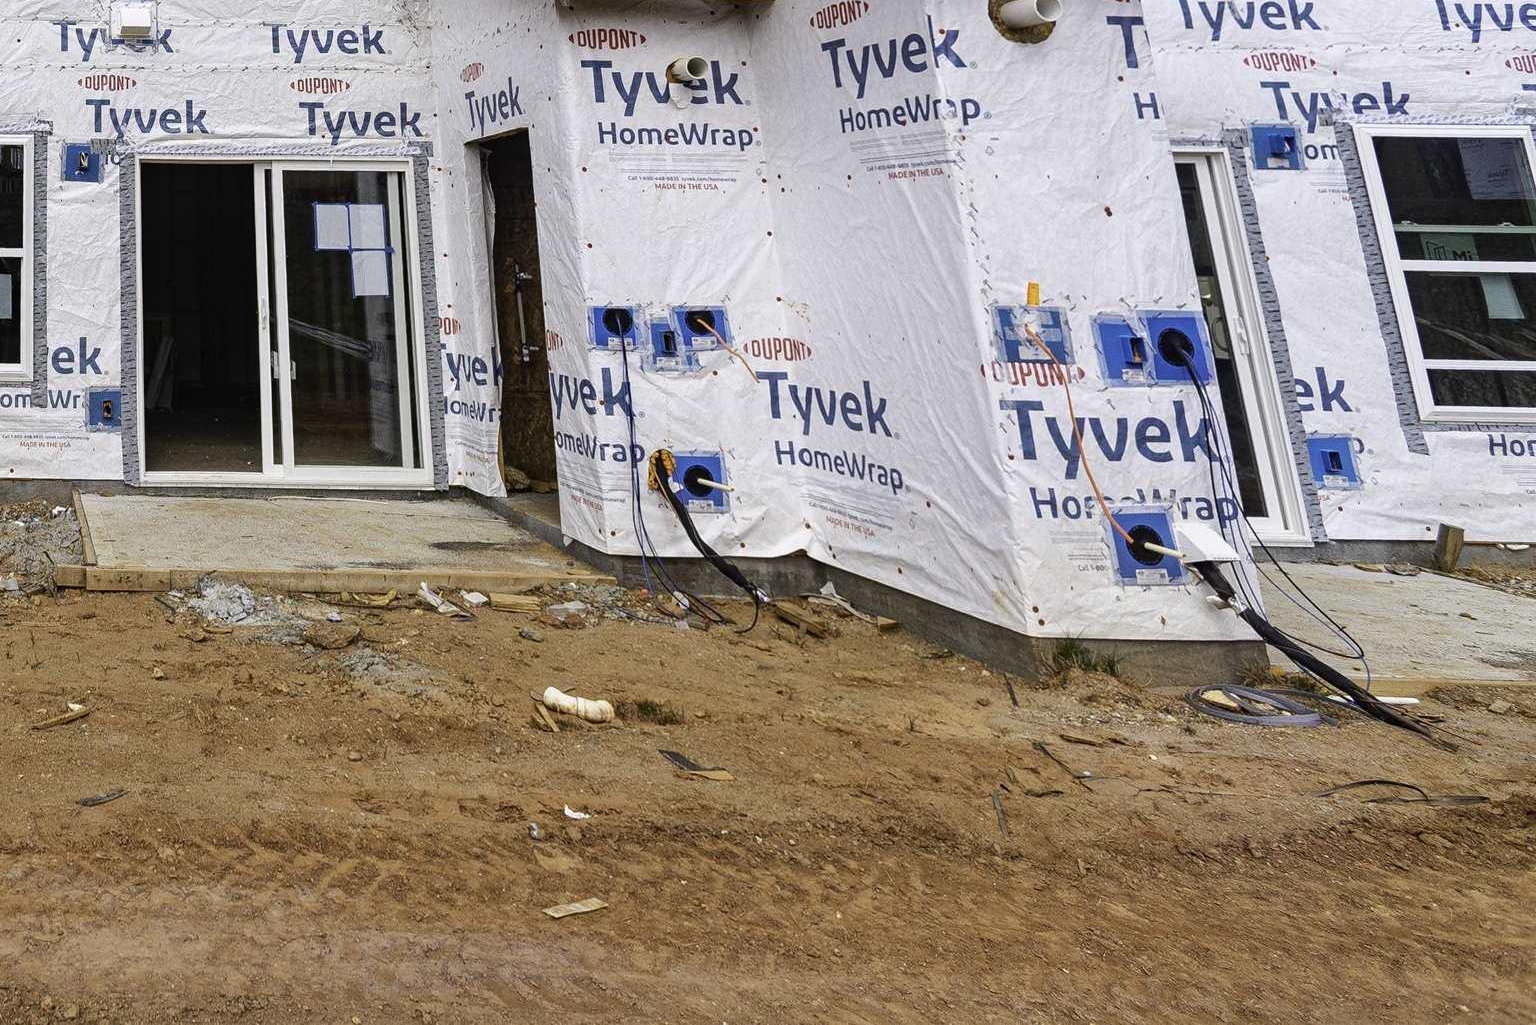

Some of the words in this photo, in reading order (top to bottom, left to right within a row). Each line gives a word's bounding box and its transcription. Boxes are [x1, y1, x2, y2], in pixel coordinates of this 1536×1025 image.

[816, 0, 863, 30] DUPONT
[264, 24, 387, 64] Tyvek
[577, 29, 638, 50] DUPONT
[821, 14, 967, 100] Tyvek
[1251, 53, 1309, 71] DUPONT
[85, 75, 131, 92] DUPONT
[298, 79, 345, 95] DUPONT
[86, 99, 209, 140] Tyvek
[299, 102, 425, 145] Tyvek
[465, 76, 523, 136] Tyvek
[598, 122, 754, 152] HomeWrap
[751, 338, 807, 361] DUPONT
[550, 368, 636, 420] yvek
[756, 371, 893, 438] Tyvek
[556, 432, 645, 467] omeWrap
[1000, 401, 1221, 480] Tyvek
[774, 440, 904, 495] HomeWrap
